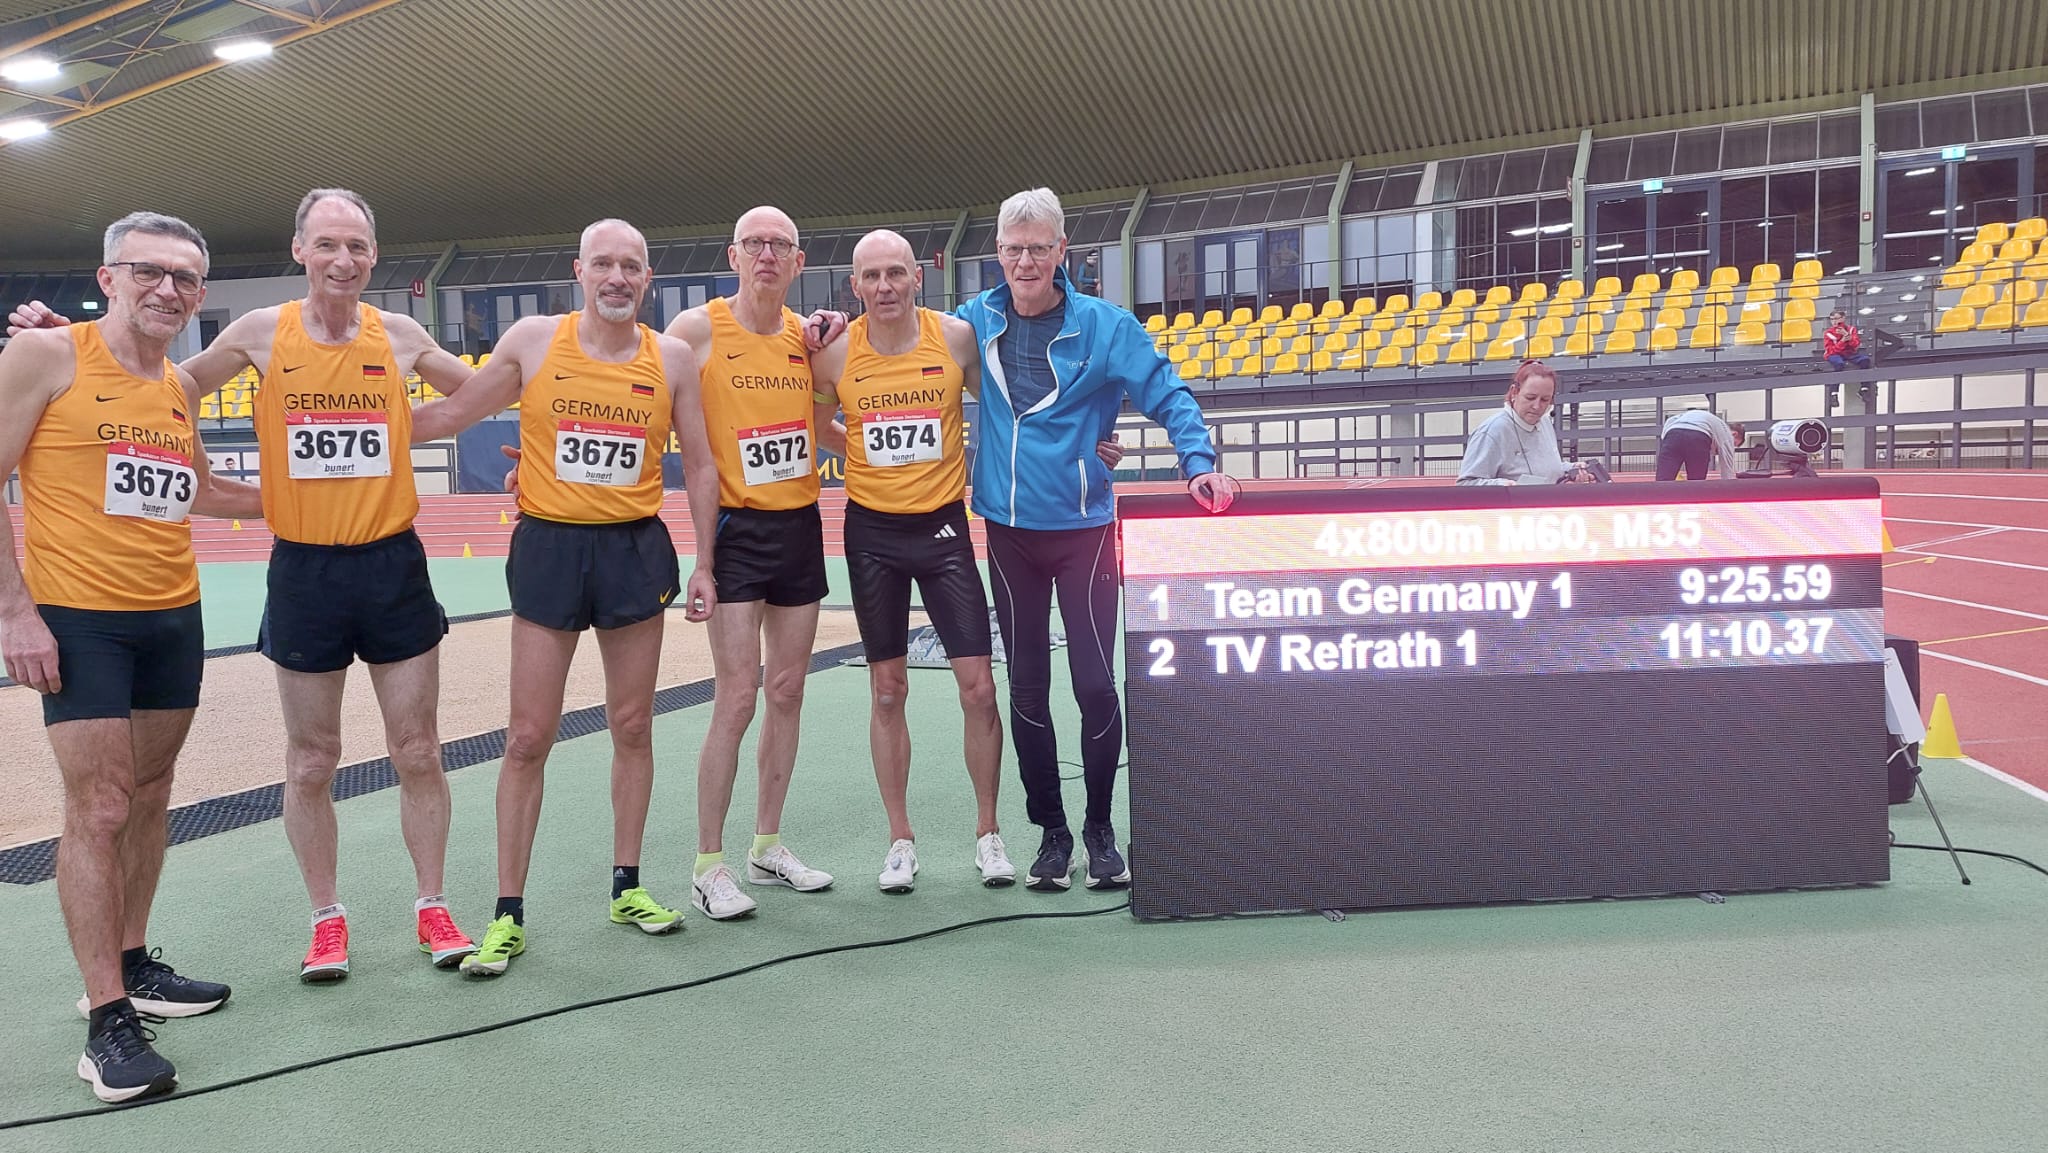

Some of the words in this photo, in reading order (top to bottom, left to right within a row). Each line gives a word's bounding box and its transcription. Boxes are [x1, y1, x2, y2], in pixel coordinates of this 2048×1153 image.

[414, 281, 423, 295] U
[731, 375, 809, 391] GERMANY
[284, 393, 388, 410] GERMANY
[551, 398, 653, 425] GERMANY
[857, 388, 946, 411] GERMANY
[97, 423, 193, 457] GERMANY
[294, 429, 381, 459] 3676
[868, 423, 936, 451] 3674
[561, 437, 637, 469] 3675
[745, 435, 808, 468] 3672
[891, 453, 915, 461] bunert
[324, 463, 355, 473] bunert
[585, 470, 612, 480] bunert
[772, 466, 795, 477] bunert
[114, 461, 191, 503] 3673
[141, 501, 168, 514] bunert
[1313, 519, 1485, 558] 4x800m
[1499, 513, 1600, 556] M60,
[1612, 510, 1703, 548] M35
[1148, 583, 1170, 621] 1
[1203, 581, 1323, 620] Team
[1336, 578, 1539, 620] Germany
[1551, 572, 1573, 609] 1
[1680, 563, 1834, 605] 9:25.59
[1148, 638, 1176, 676] 2
[1205, 635, 1266, 674] TV
[1280, 631, 1441, 672] Refrath
[1456, 630, 1477, 666] 1
[1660, 617, 1834, 660] 11:10.37
